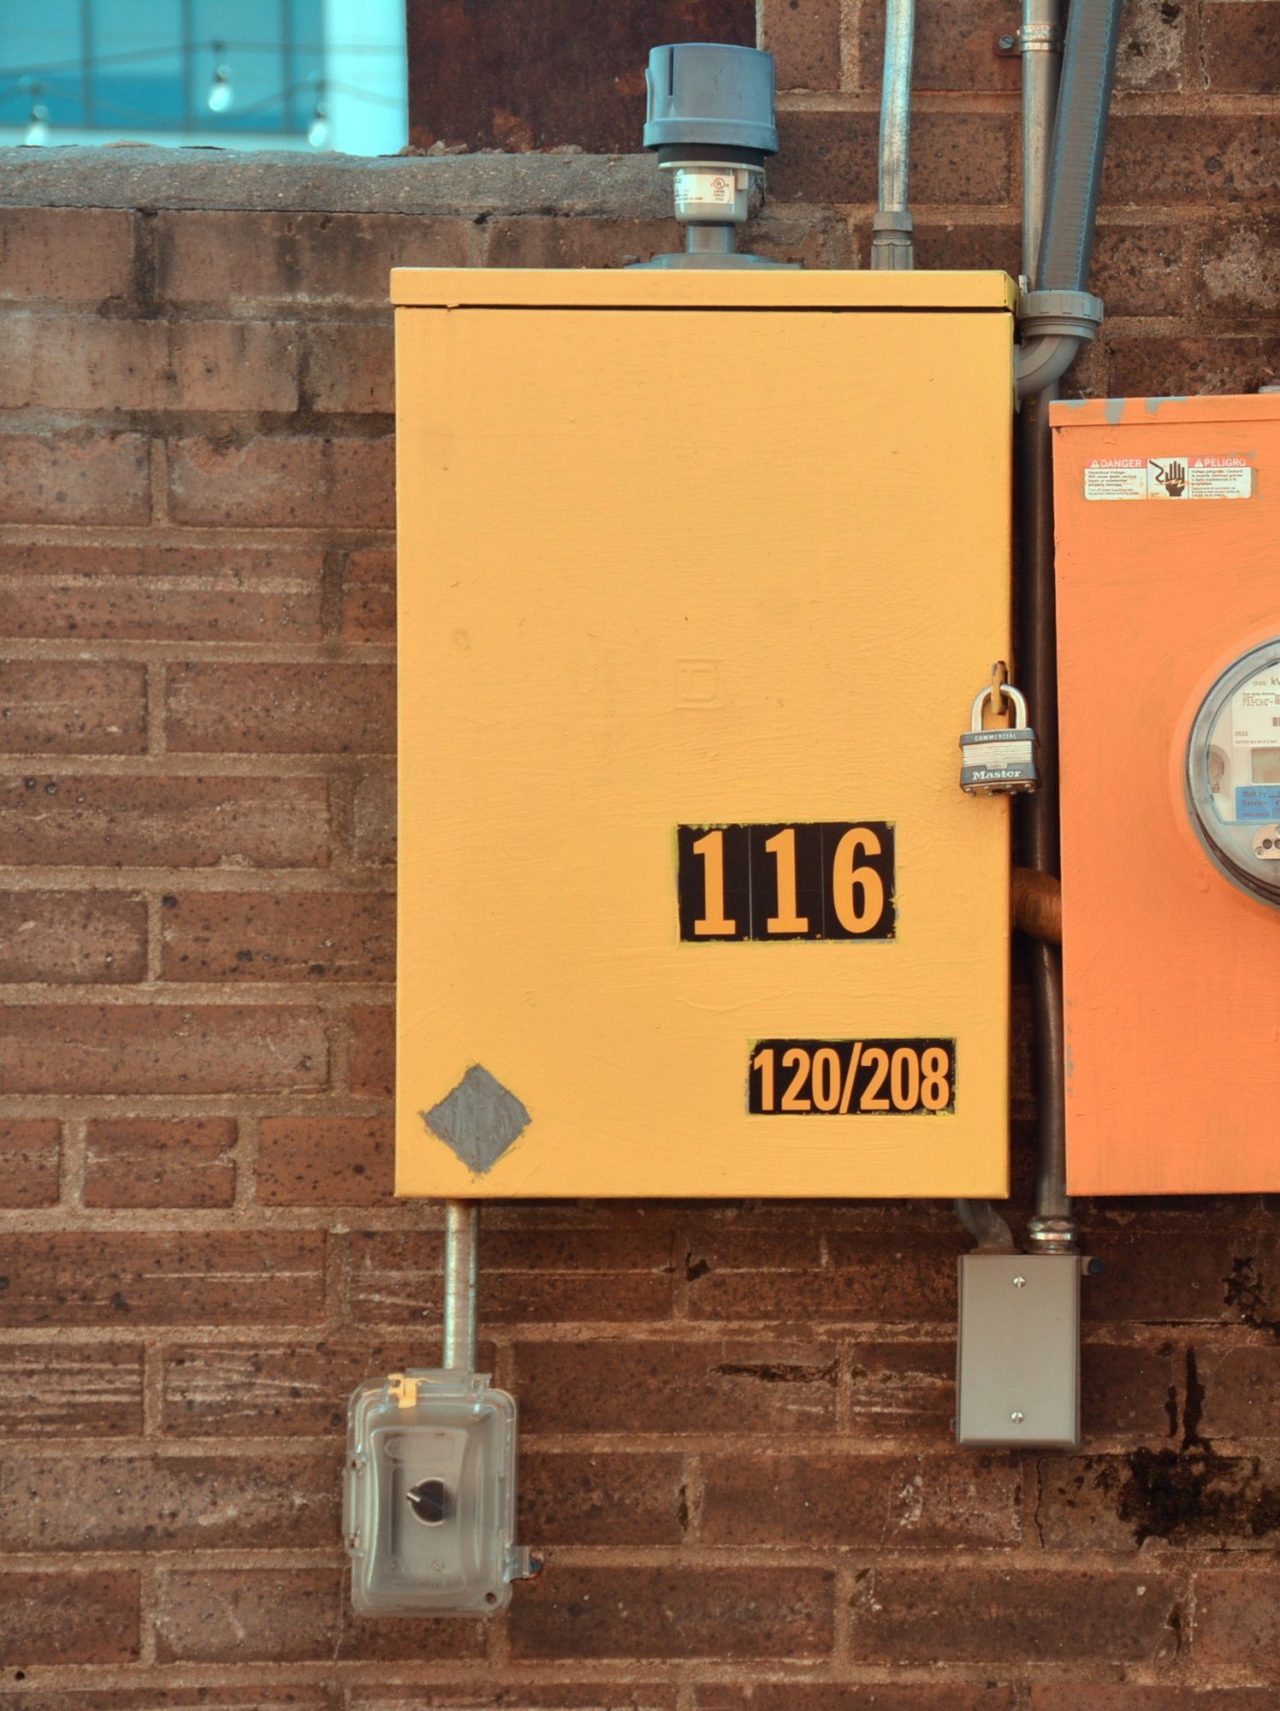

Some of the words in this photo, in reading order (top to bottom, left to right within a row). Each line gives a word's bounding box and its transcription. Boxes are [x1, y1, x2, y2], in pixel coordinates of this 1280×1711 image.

[1100, 459, 1141, 468] DANGER
[1204, 458, 1246, 467] PELIGRO
[974, 733, 1017, 742] COMMERCIAL
[972, 769, 1021, 781] Master
[693, 827, 884, 935] 116
[753, 1042, 949, 1114] 120/208
